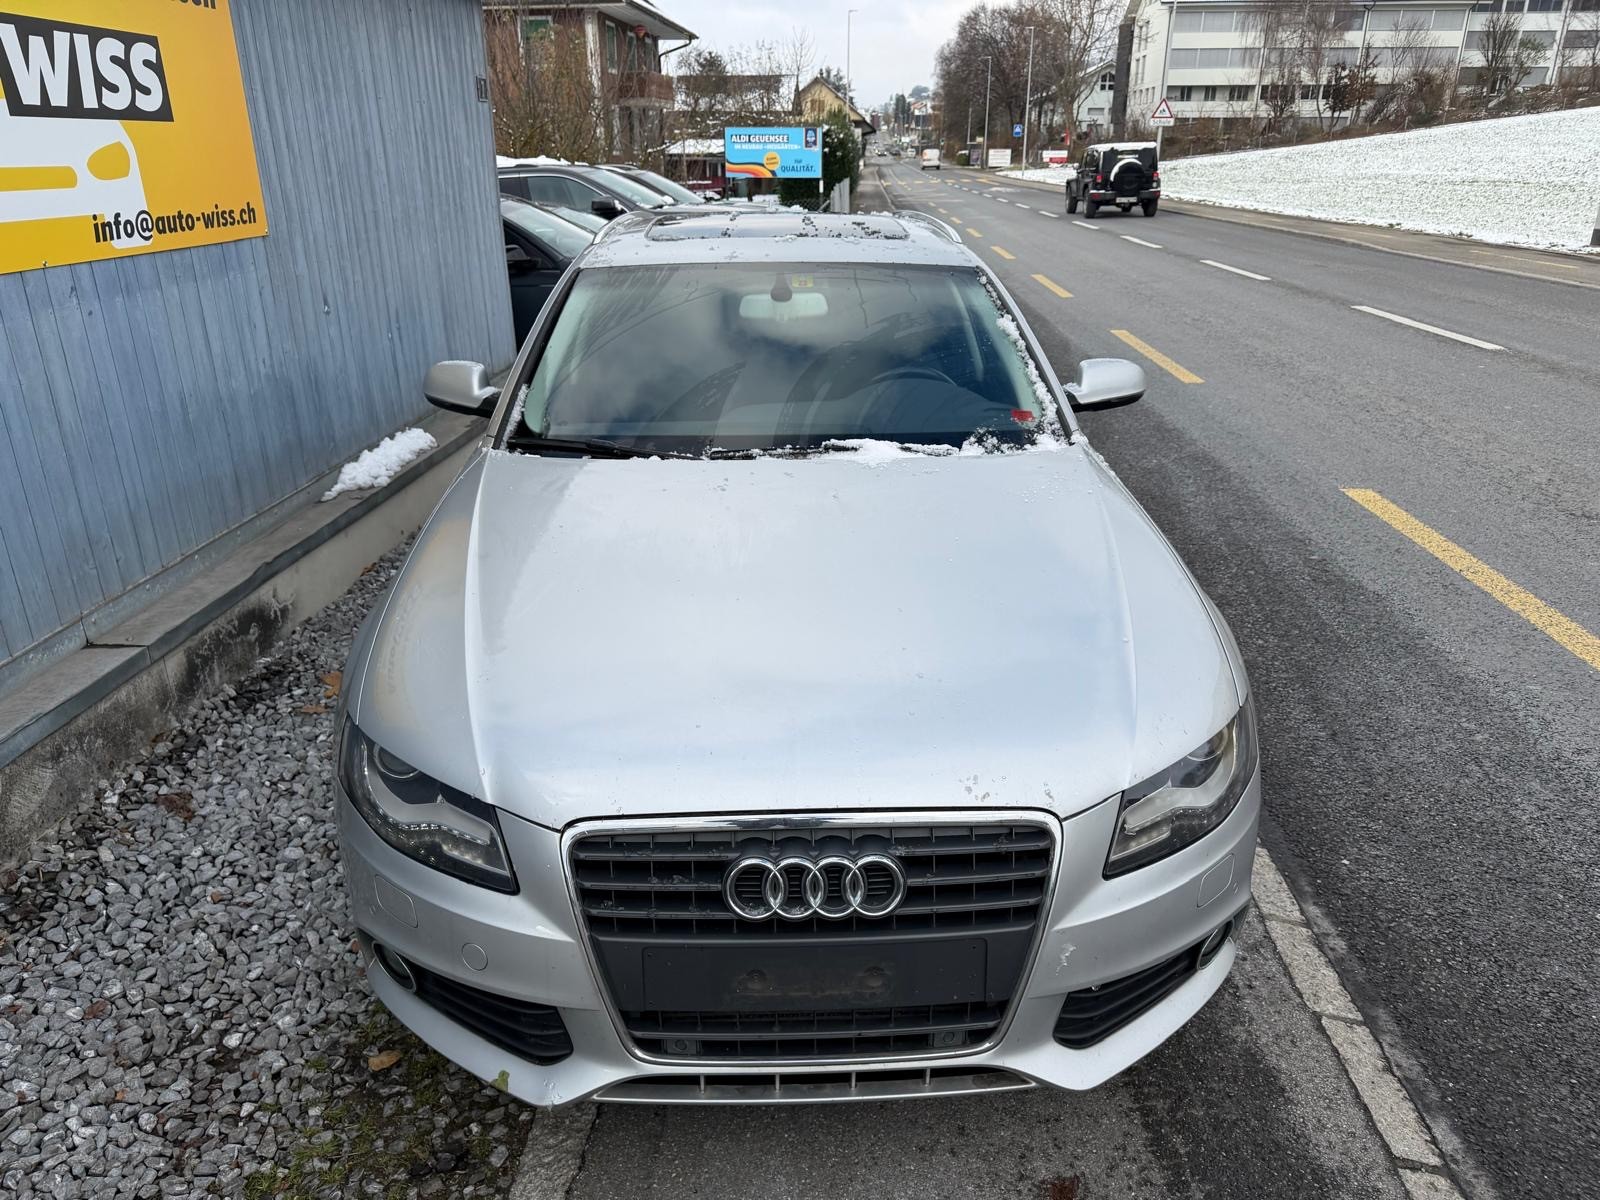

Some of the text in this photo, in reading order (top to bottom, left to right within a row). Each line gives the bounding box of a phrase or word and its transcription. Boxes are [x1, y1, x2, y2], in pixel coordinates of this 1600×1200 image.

[0, 22, 163, 112] WISS
[731, 135, 788, 143] ALDI GEUENSEE
[92, 201, 257, 243] info@auto-wiss.ch
